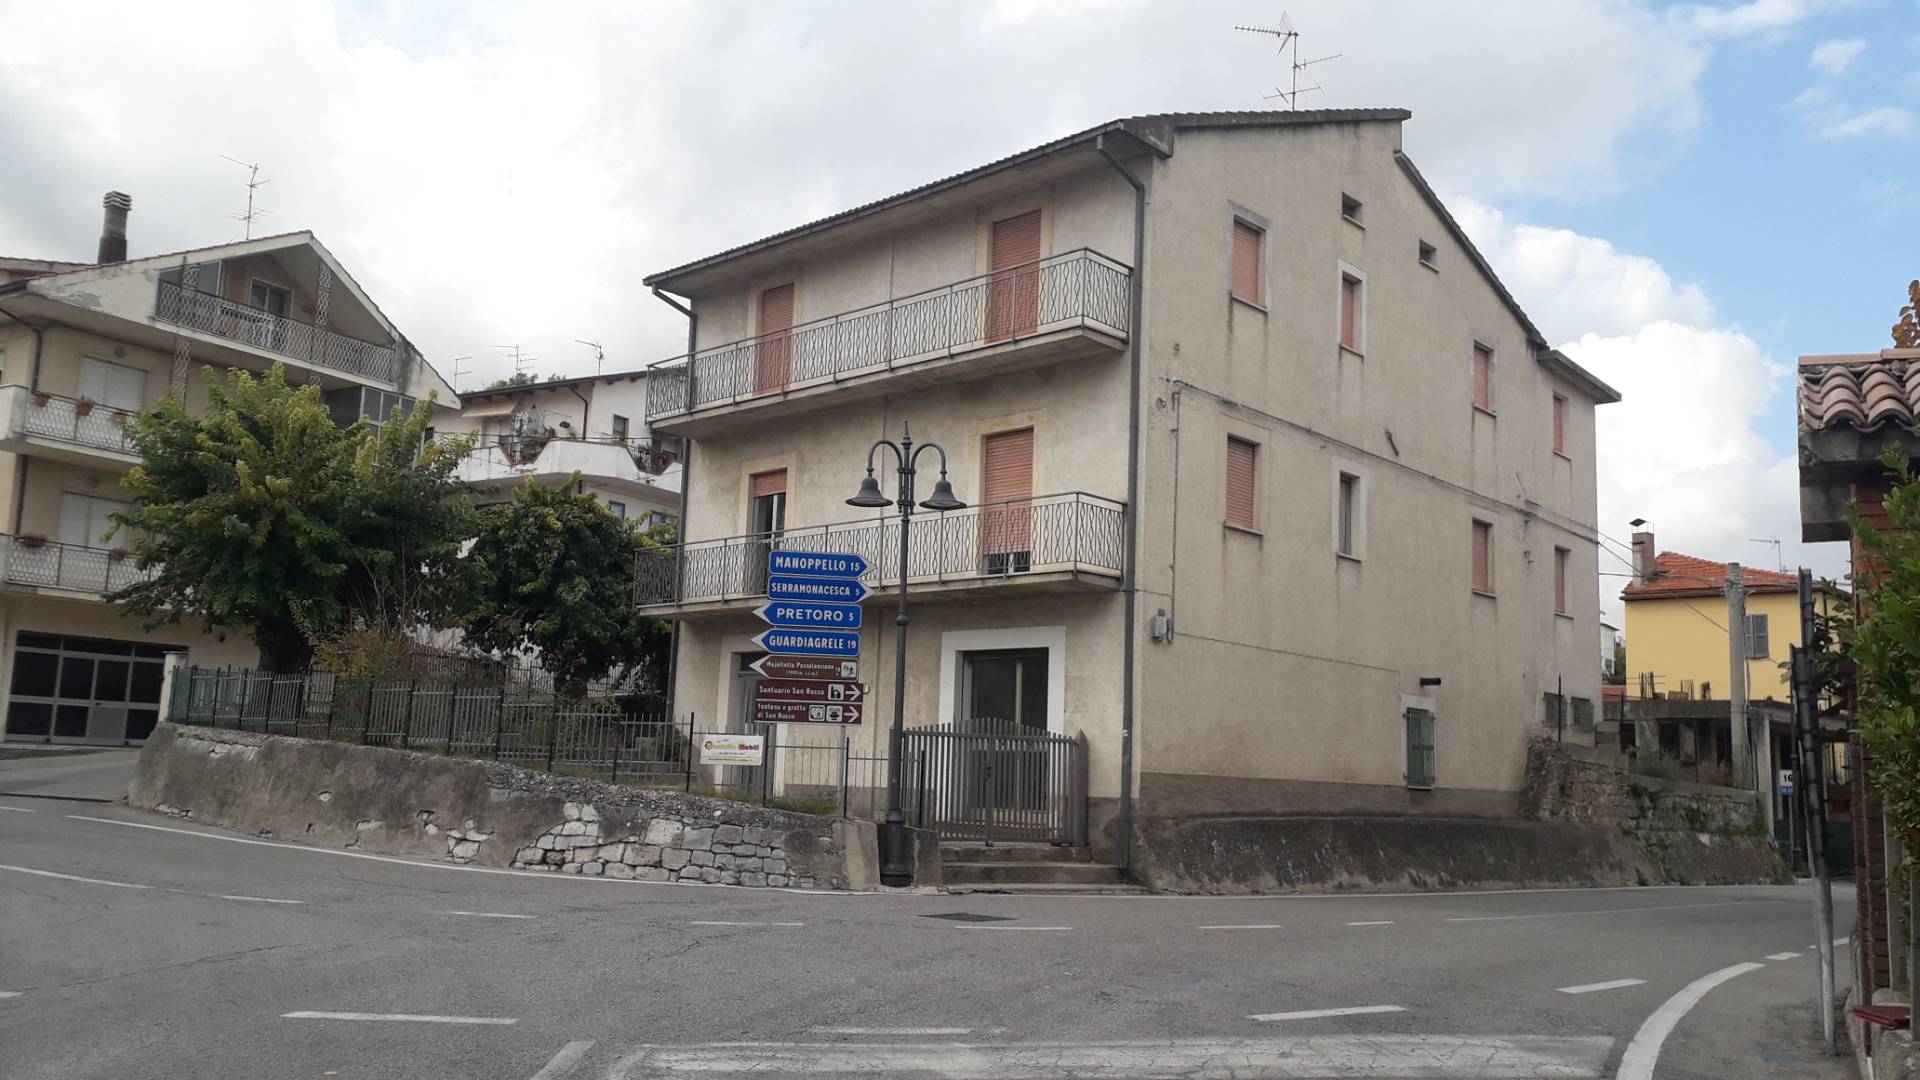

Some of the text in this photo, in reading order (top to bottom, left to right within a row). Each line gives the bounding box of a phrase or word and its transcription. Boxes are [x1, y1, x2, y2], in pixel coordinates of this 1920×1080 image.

[775, 556, 860, 571] MANOPPELLO 15
[771, 582, 850, 596] SERRAMONACESCA
[776, 607, 854, 622] PRETORO 5
[769, 635, 856, 650] GUARDIAGRELE 19
[759, 685, 825, 696] Santuario San Rocco
[757, 711, 764, 719] di
